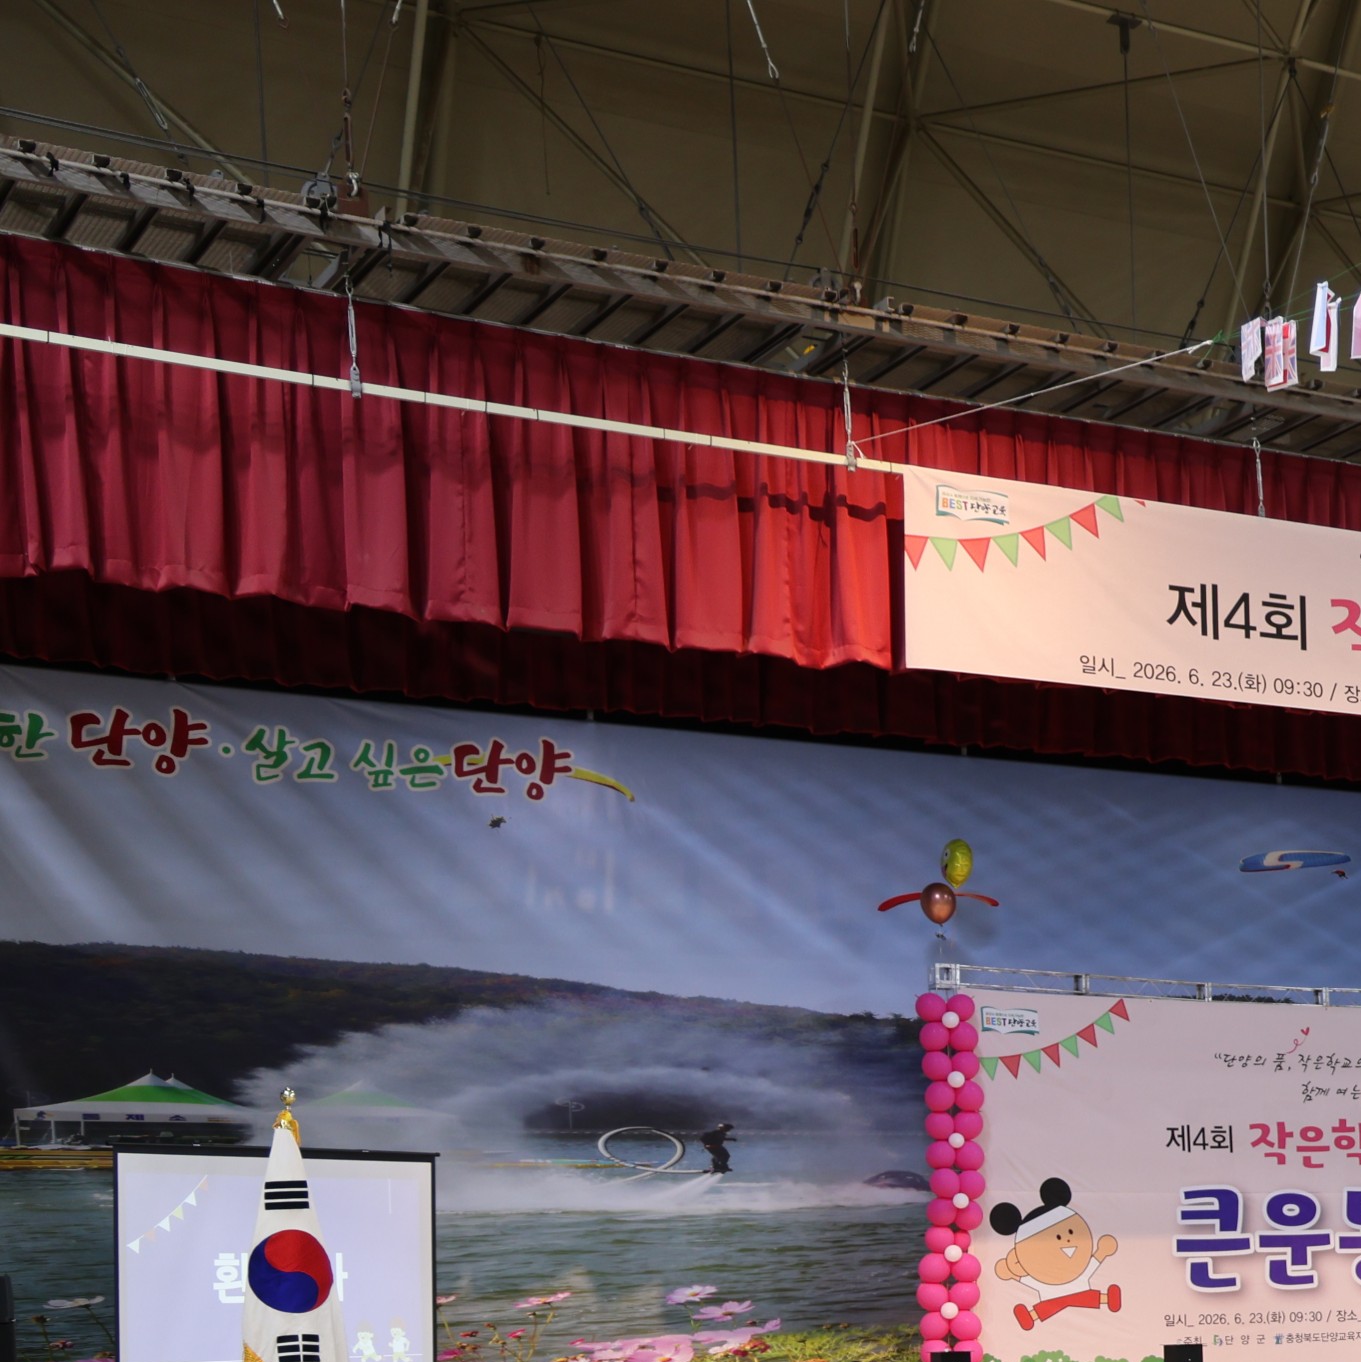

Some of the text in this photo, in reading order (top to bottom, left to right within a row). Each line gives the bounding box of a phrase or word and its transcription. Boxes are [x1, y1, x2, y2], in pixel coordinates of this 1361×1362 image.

[941, 496, 969, 511] BEST
[1166, 583, 1308, 651] 제4회
[1133, 661, 1182, 685] 2026.
[1188, 668, 1205, 687] 6.
[1211, 670, 1267, 694] 23.(화)
[1273, 678, 1324, 699] 09:30
[70, 709, 208, 774] 단양
[245, 728, 335, 781] 살고
[352, 742, 444, 787] 싶은
[453, 738, 572, 800] 단양
[985, 1016, 1006, 1027] BEST
[1273, 1052, 1291, 1072] 품,
[1301, 1081, 1329, 1103] 함께
[1337, 1085, 1361, 1099] 여는
[1165, 1124, 1234, 1153] 제4회
[1198, 1313, 1230, 1326] 2026.
[1234, 1313, 1245, 1325] 6.
[1289, 1311, 1322, 1323] 09:30
